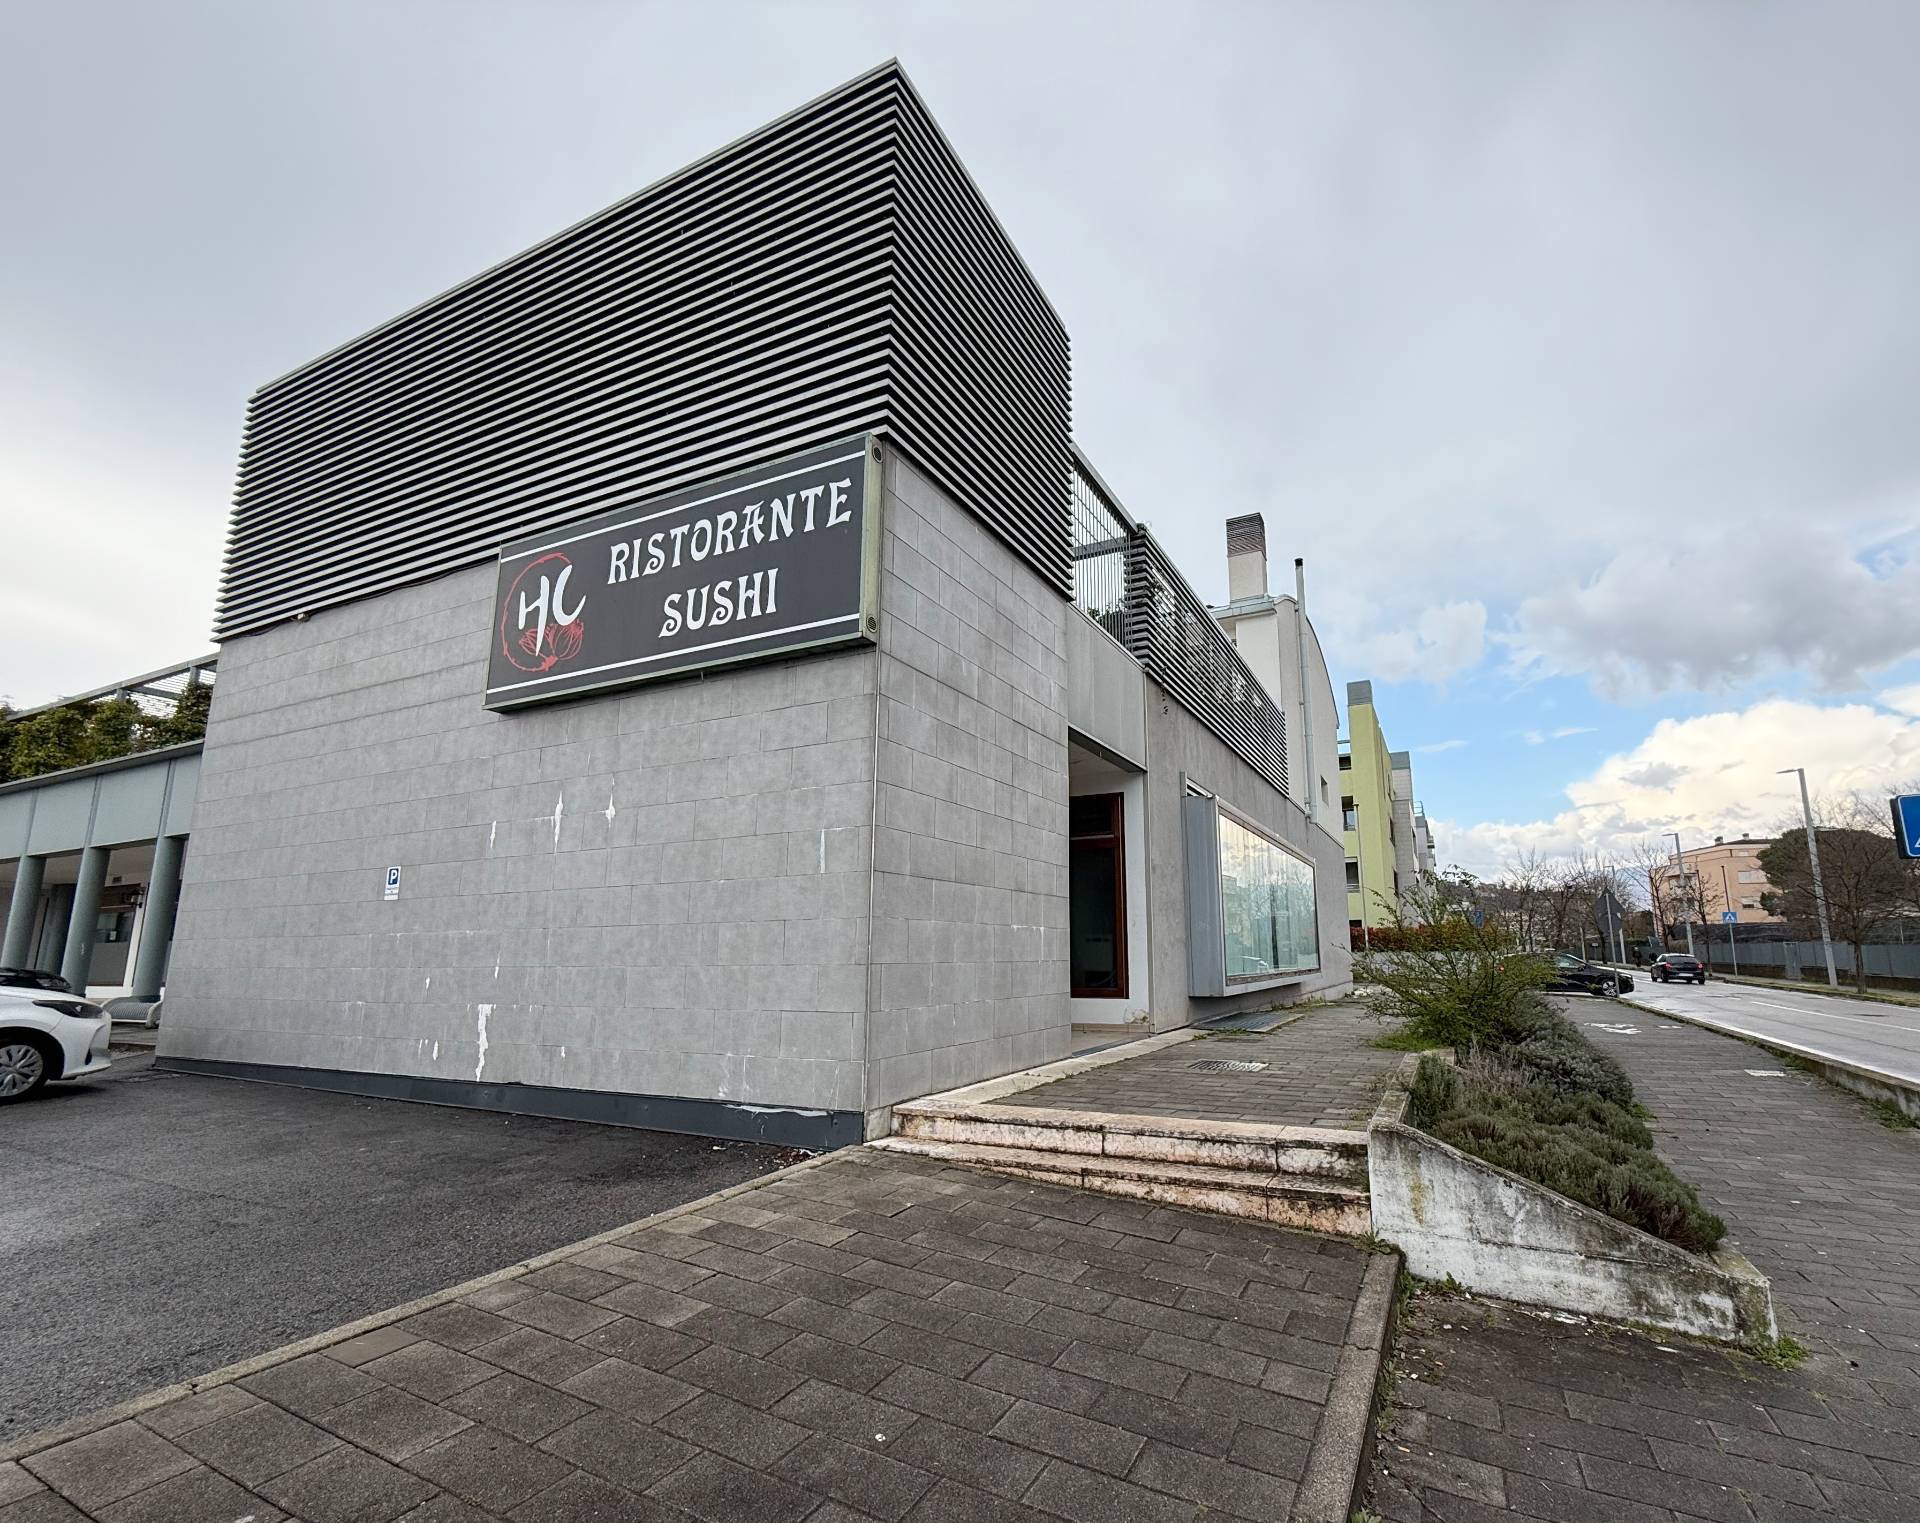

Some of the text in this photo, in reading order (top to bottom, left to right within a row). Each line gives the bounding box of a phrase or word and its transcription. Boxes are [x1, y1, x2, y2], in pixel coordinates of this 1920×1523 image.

[607, 477, 853, 585] RISTORANTE
[518, 565, 586, 656] HC
[658, 567, 779, 638] SUSHI
[390, 869, 398, 884] P
